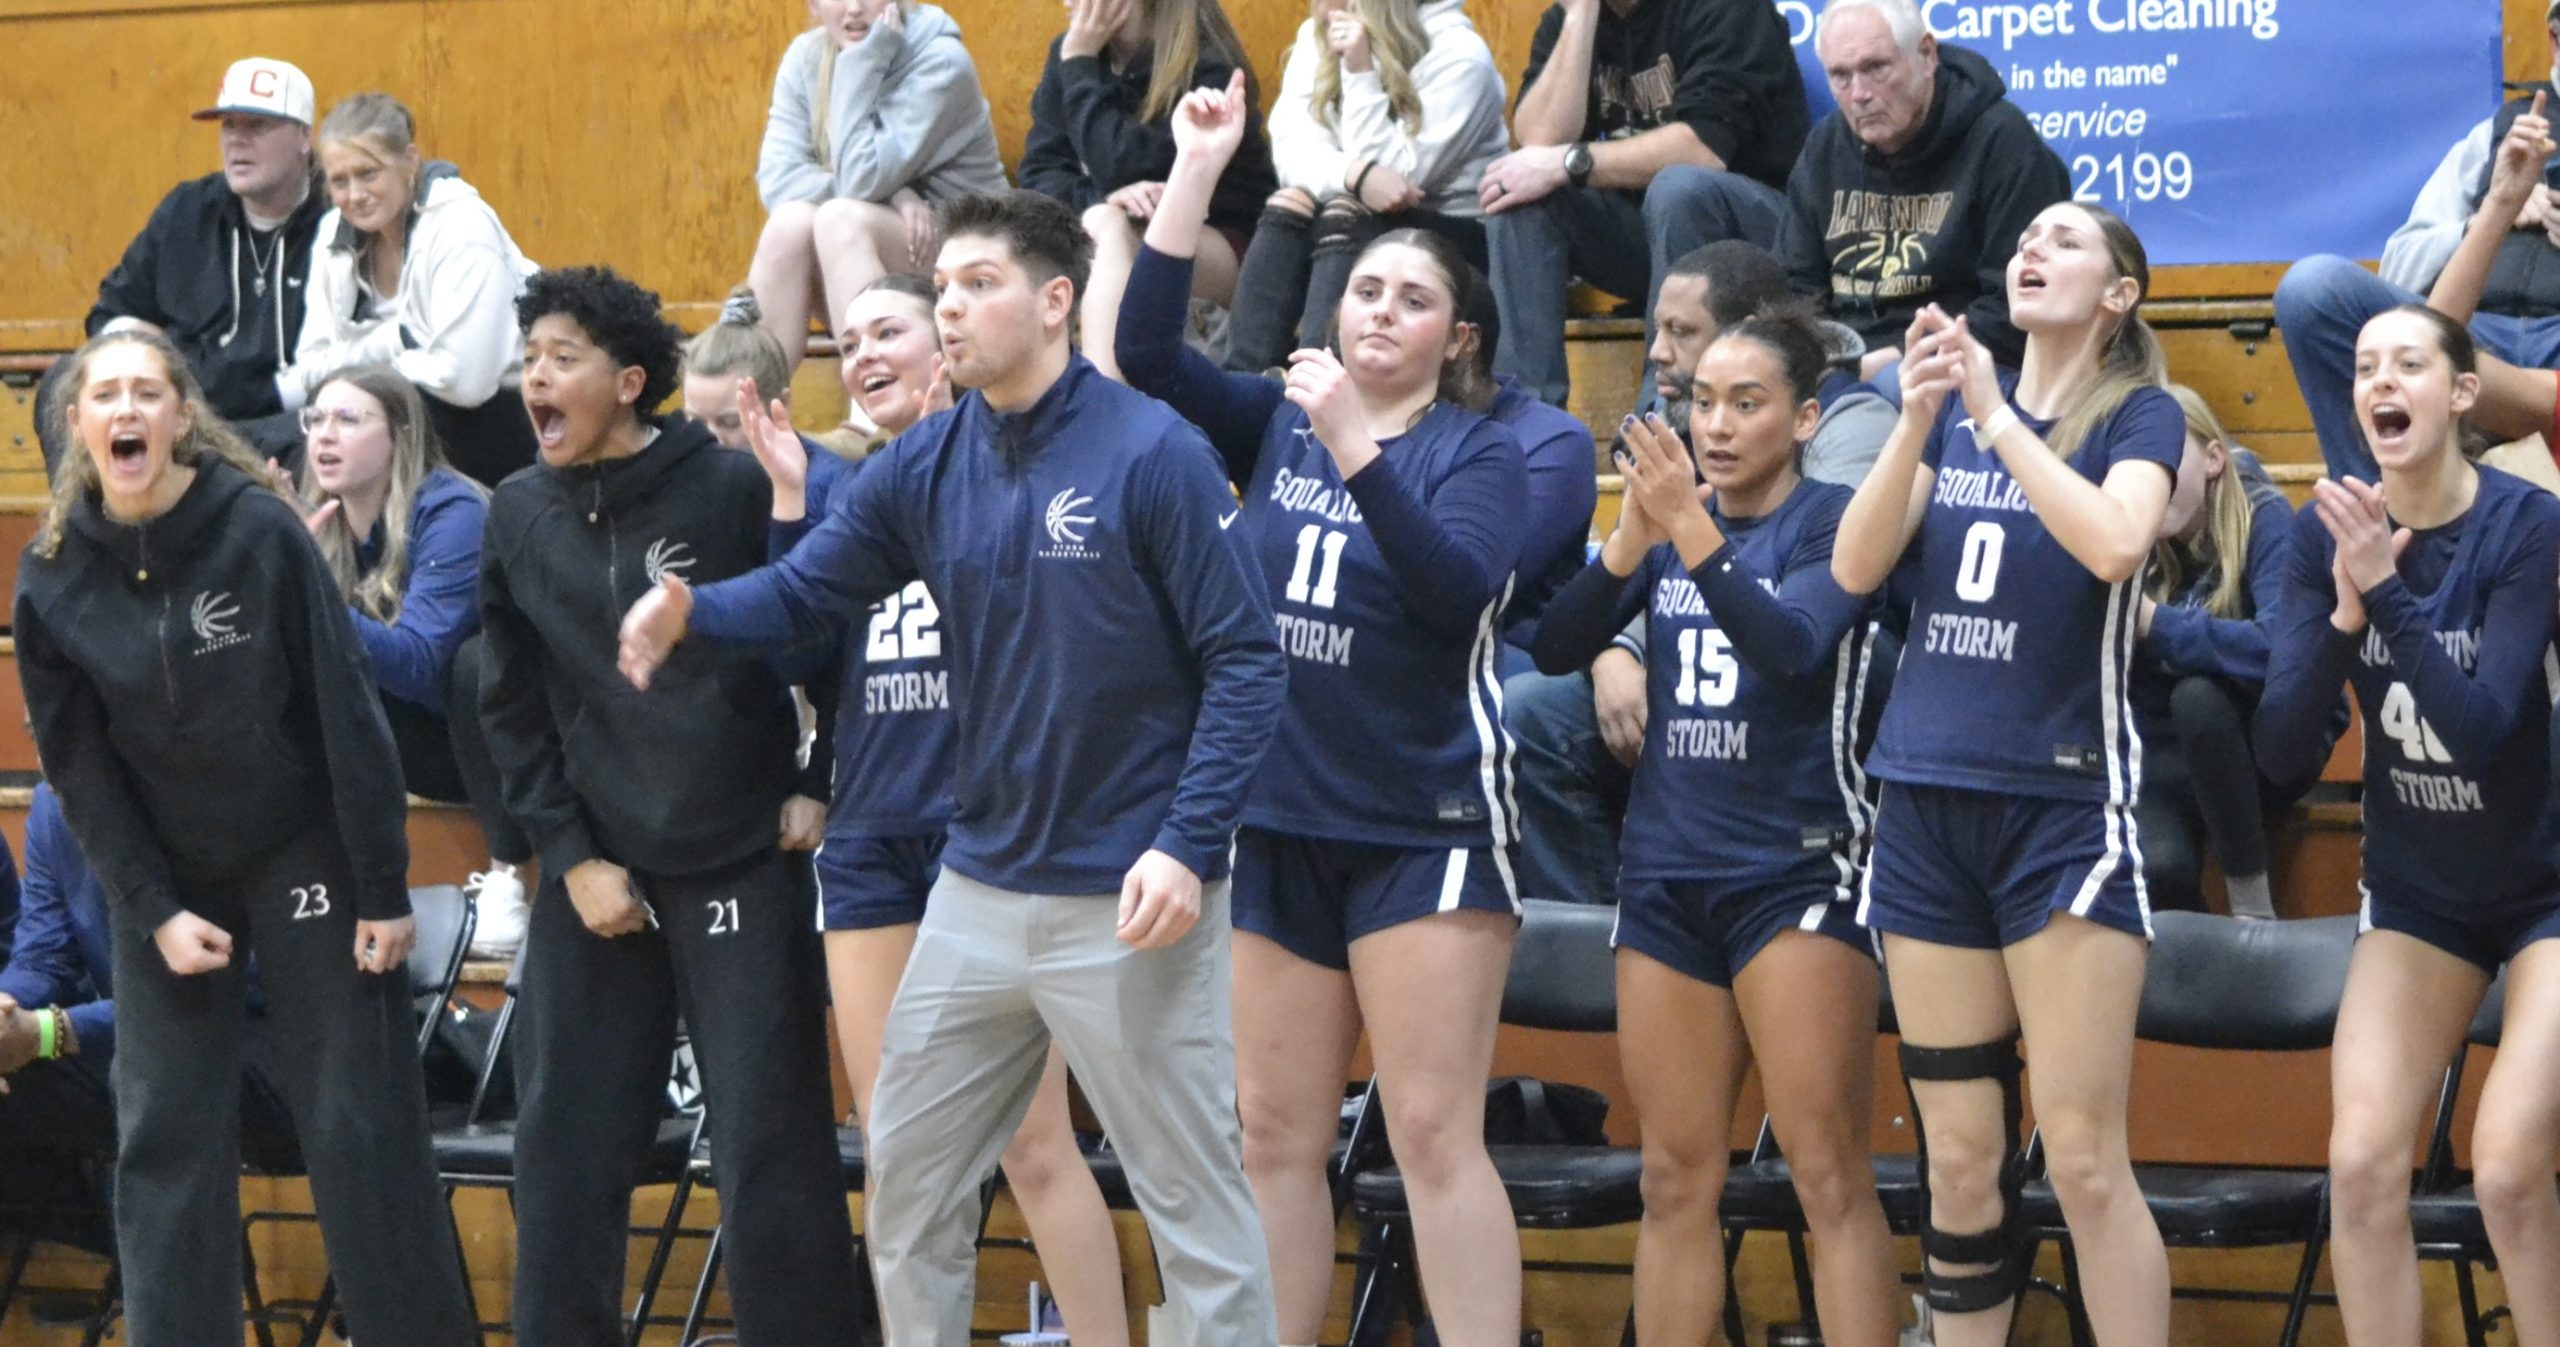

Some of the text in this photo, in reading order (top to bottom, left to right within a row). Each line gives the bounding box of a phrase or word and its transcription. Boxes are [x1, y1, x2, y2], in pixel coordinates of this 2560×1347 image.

[1921, 0, 2279, 50] Carpet Cleaning
[250, 70, 277, 98] C
[2011, 54, 2178, 91] in the name"
[2072, 151, 2192, 202] 2199
[1934, 467, 2036, 514] SQUALIC
[1286, 524, 1348, 609] 11
[1955, 521, 2005, 603] 0
[865, 579, 941, 663] 22
[1275, 613, 1354, 667] TORM
[1924, 612, 2018, 662] STORM
[1675, 628, 1739, 707] 15
[865, 670, 949, 715] STORM
[1666, 719, 1748, 760] STORM
[2390, 768, 2484, 812] STORM
[290, 883, 331, 919] 23
[706, 898, 739, 934] 21
